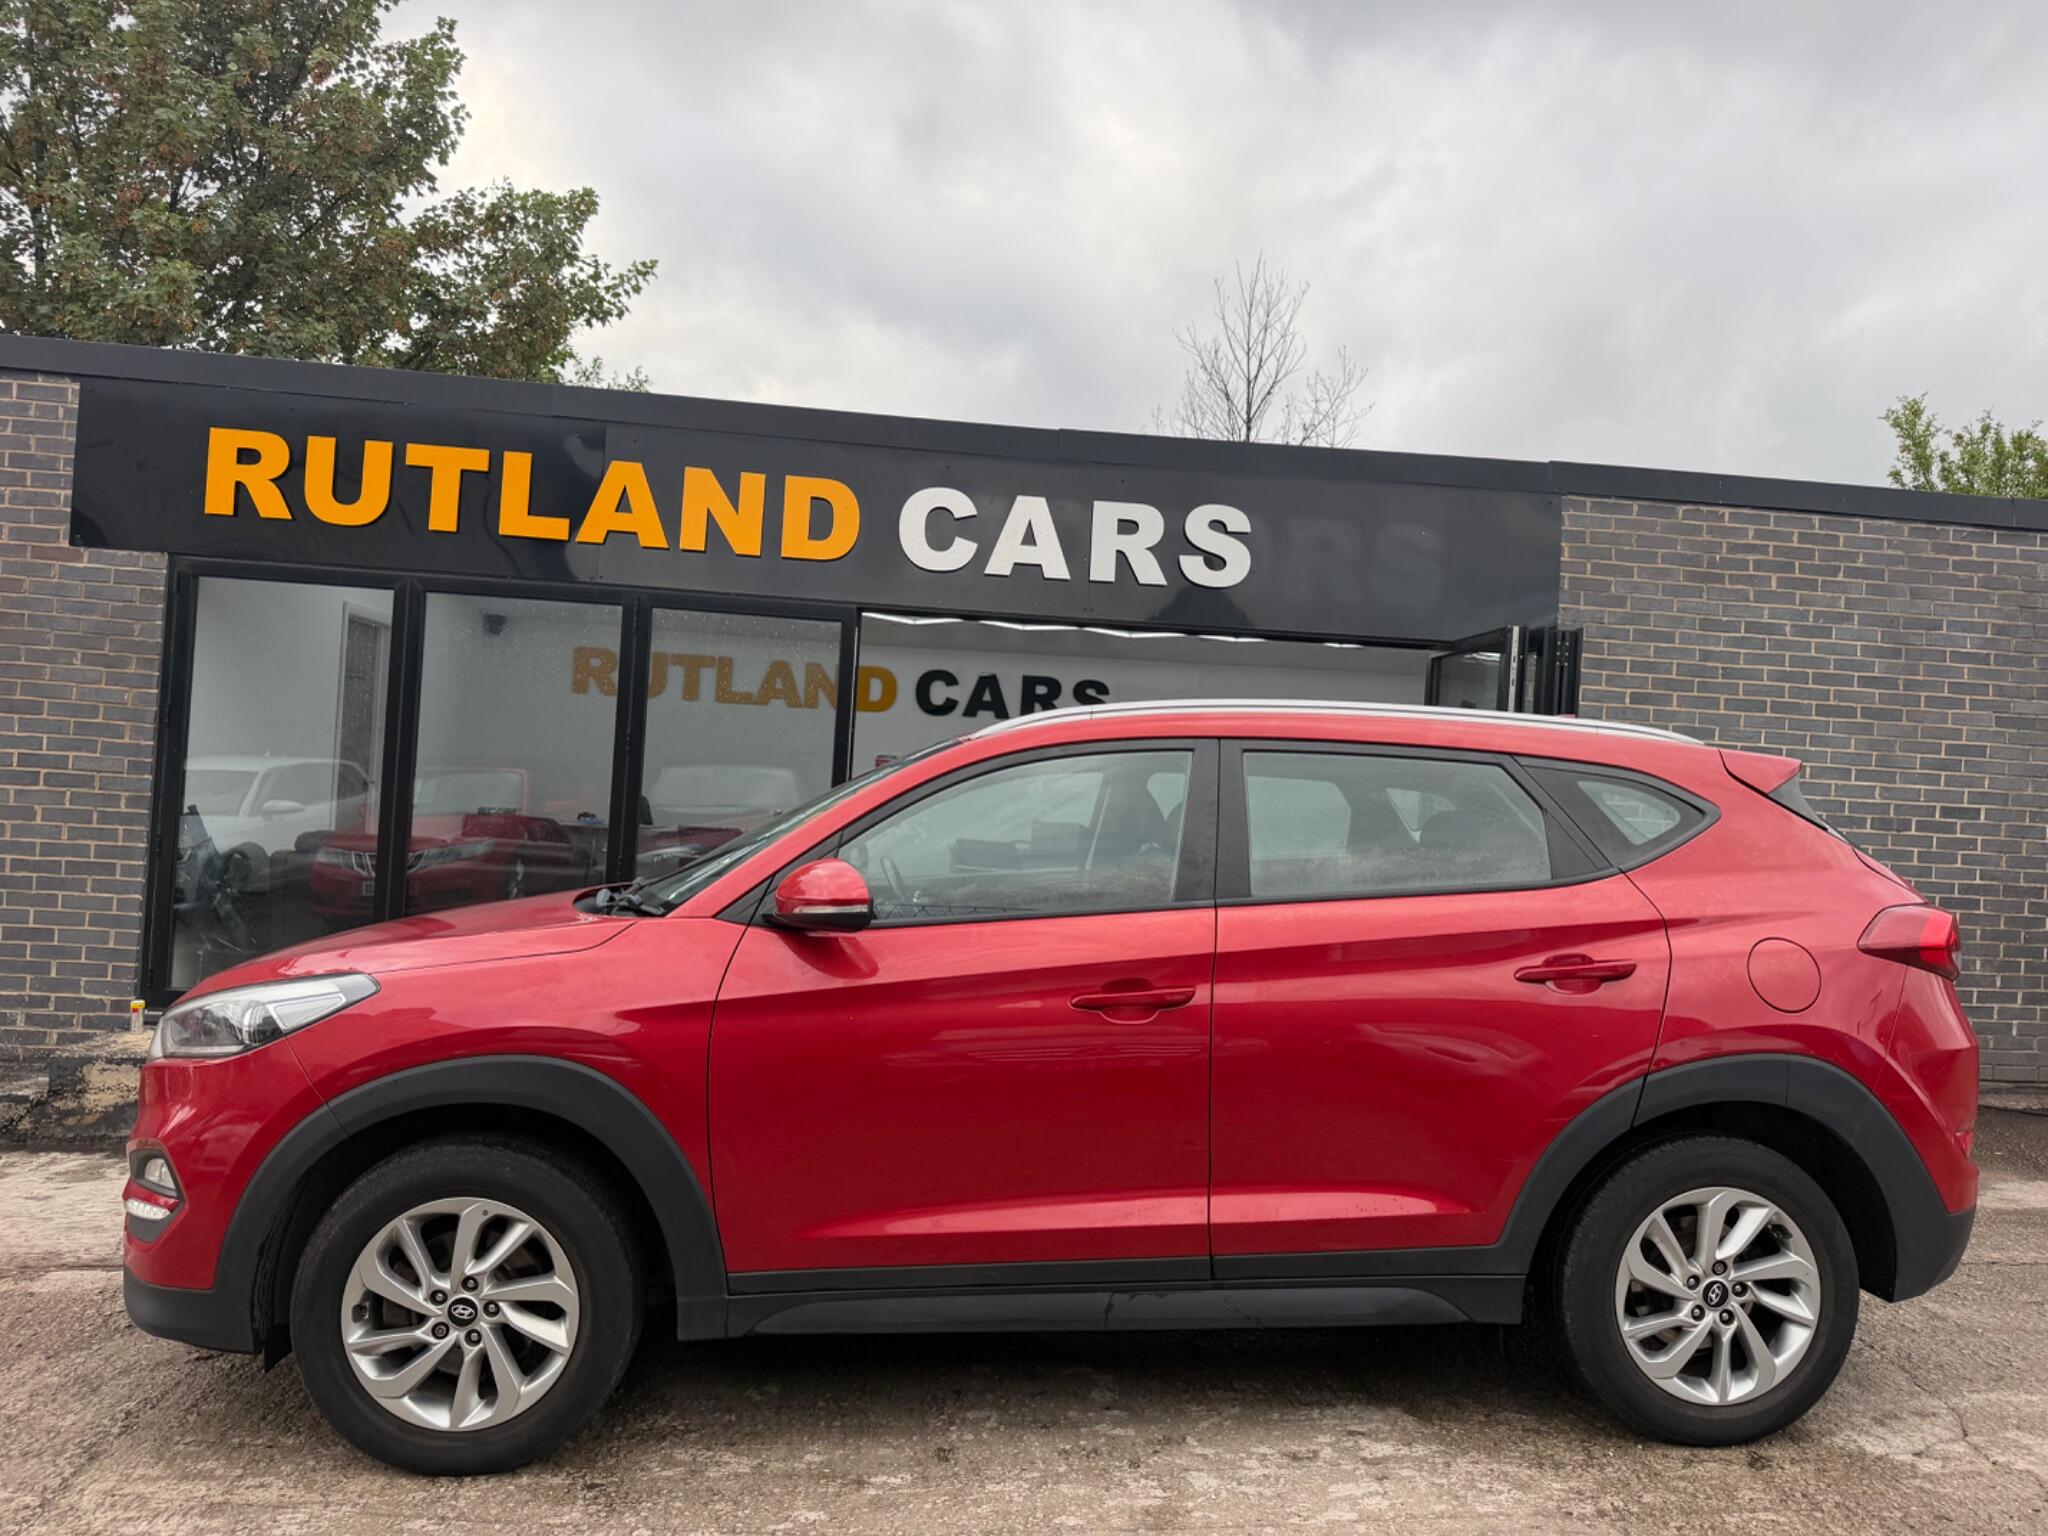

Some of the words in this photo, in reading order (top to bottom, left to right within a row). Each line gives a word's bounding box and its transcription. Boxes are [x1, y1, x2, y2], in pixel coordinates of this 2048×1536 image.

[205, 426, 861, 561] RUTLAND
[898, 486, 1252, 588] CARS
[916, 669, 1110, 720] CARS
